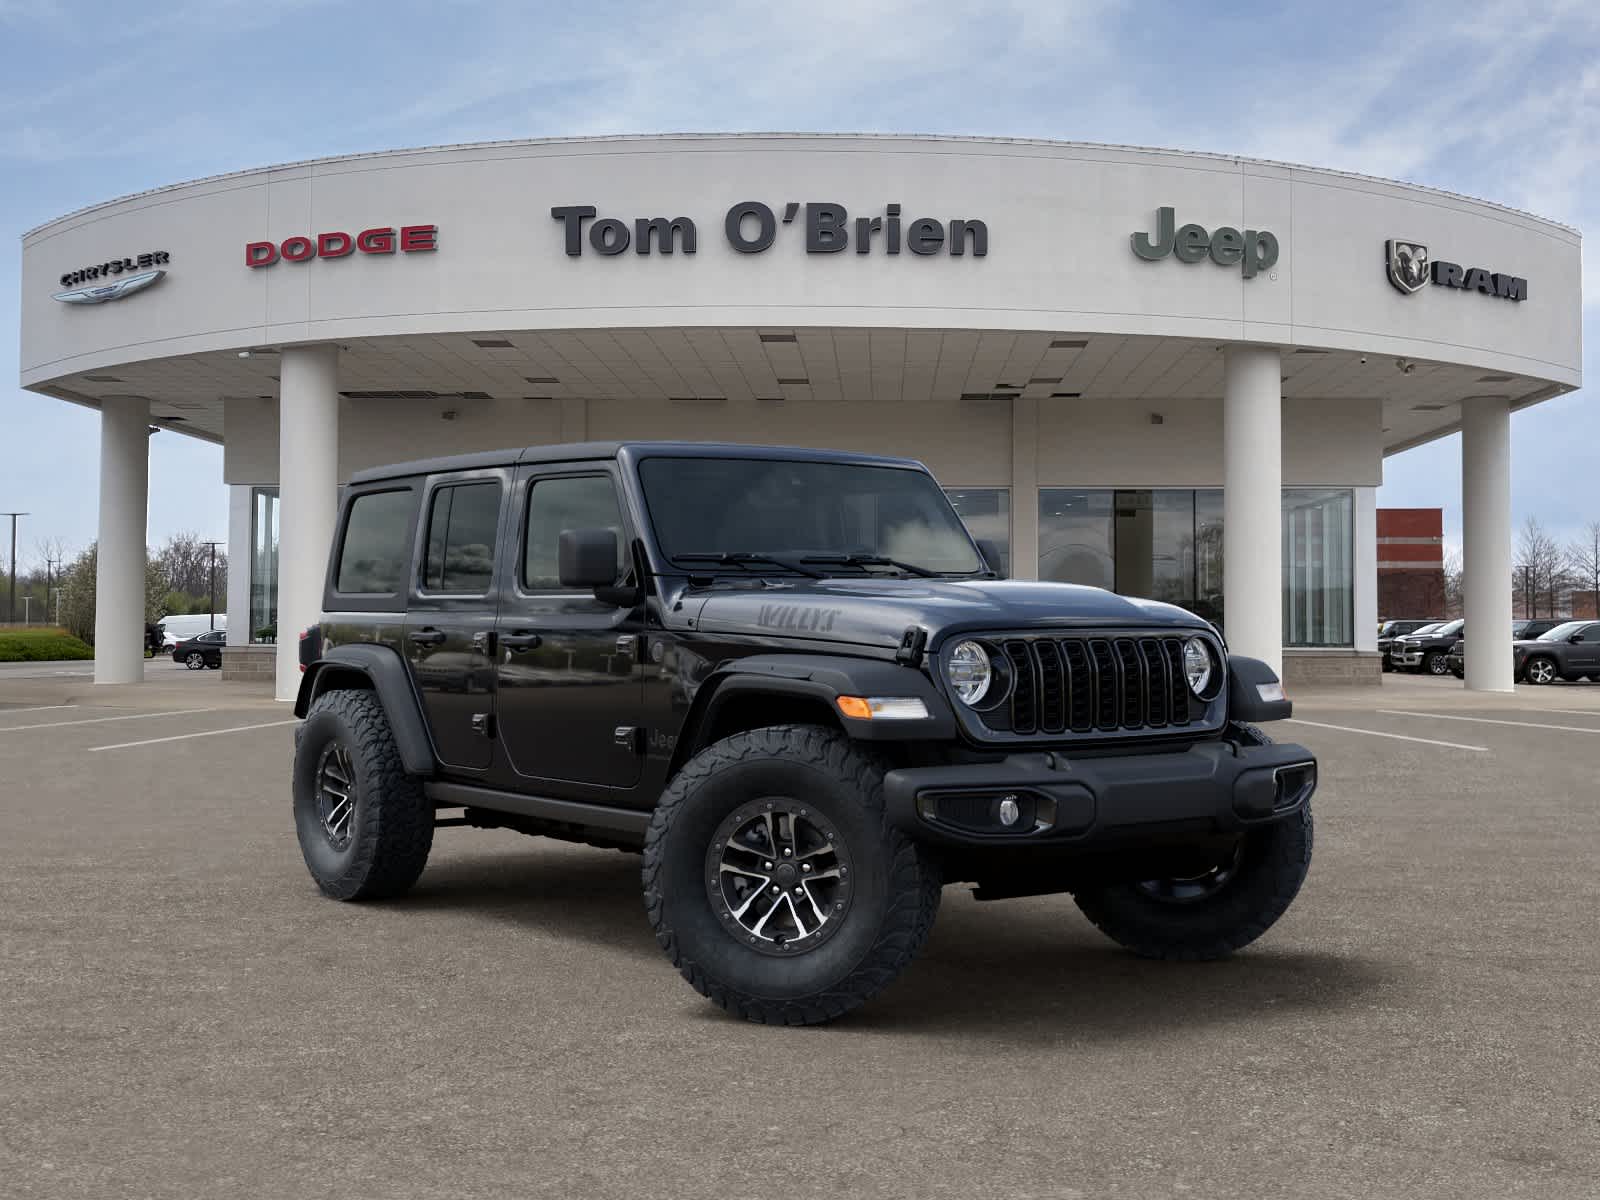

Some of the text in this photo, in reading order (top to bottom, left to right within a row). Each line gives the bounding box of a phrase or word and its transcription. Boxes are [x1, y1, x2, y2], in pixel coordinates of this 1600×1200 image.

[245, 224, 439, 269] DODGE
[551, 201, 989, 257] Tom O'Brien
[1130, 206, 1280, 279] Jeep
[60, 249, 170, 288] CHRYSLER
[1431, 260, 1528, 301] RAM
[757, 604, 843, 632] WILLYS
[648, 728, 679, 750] Jee
